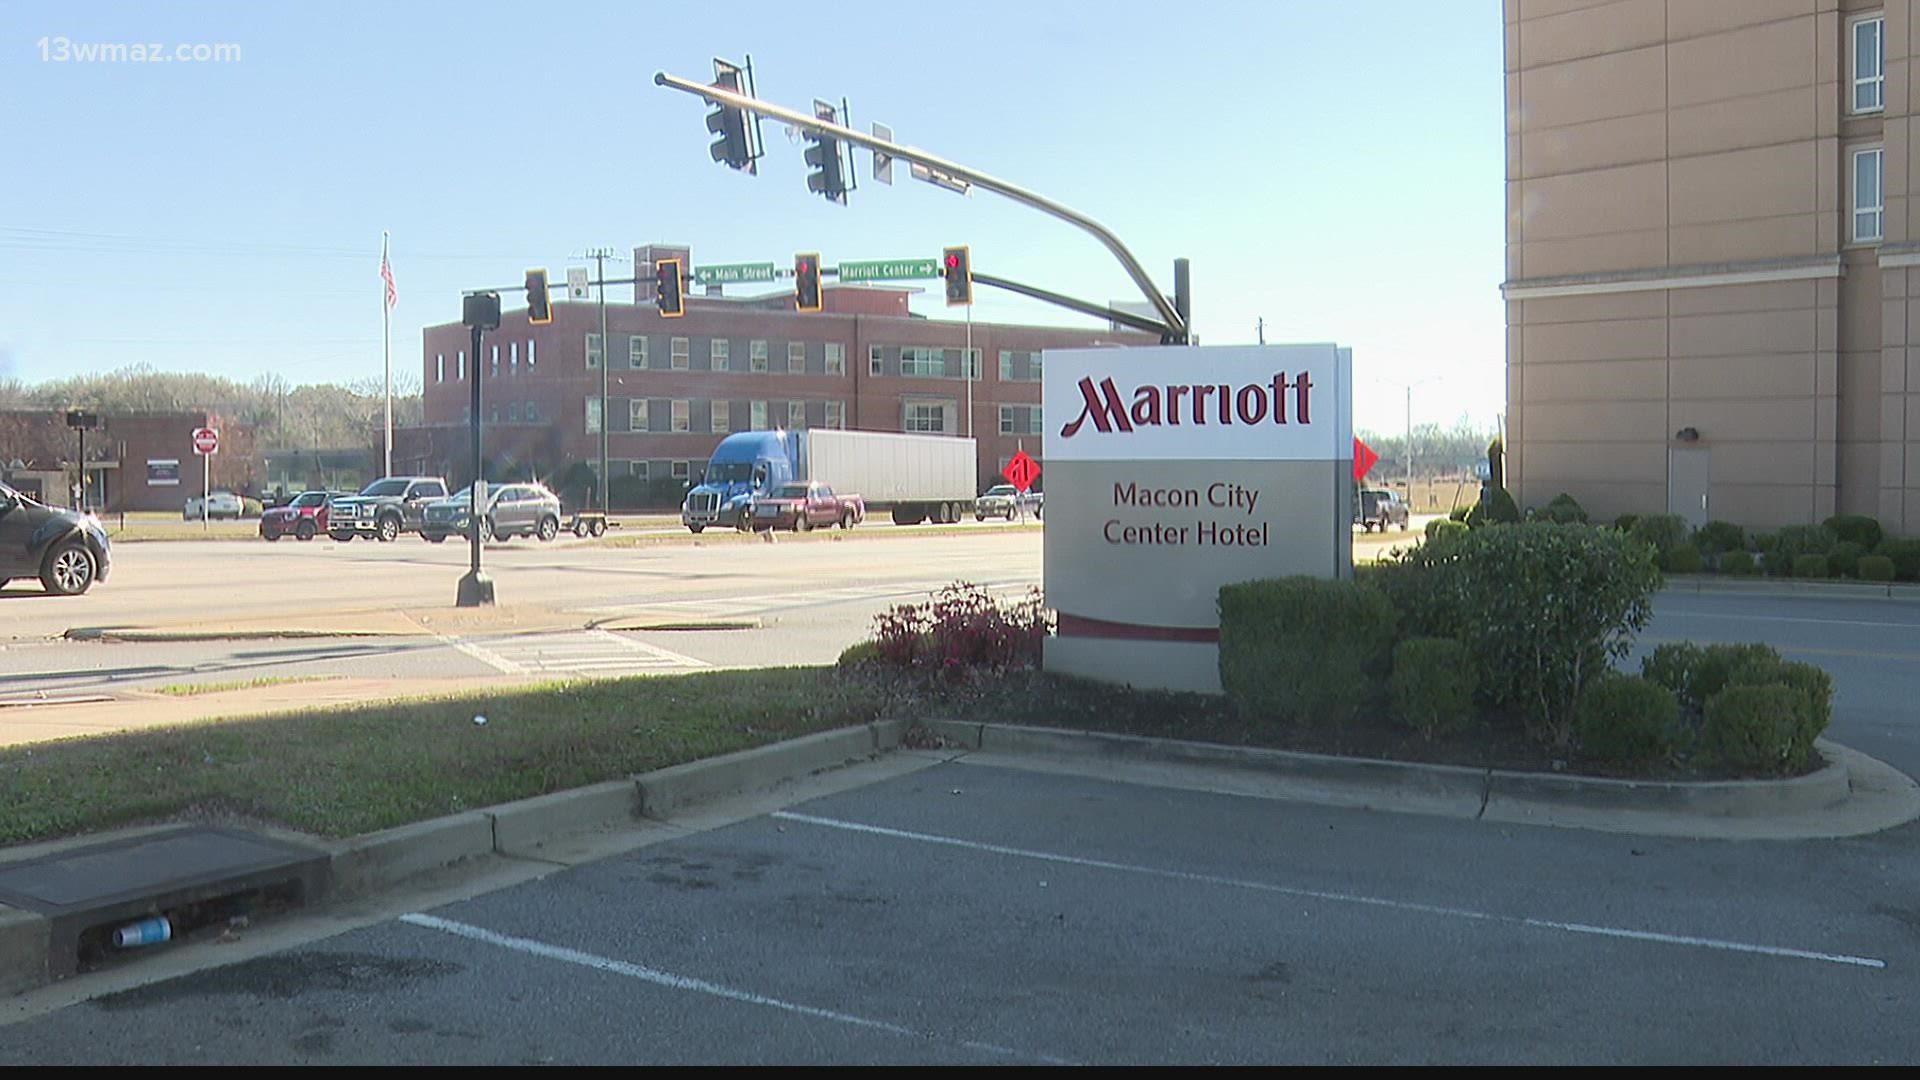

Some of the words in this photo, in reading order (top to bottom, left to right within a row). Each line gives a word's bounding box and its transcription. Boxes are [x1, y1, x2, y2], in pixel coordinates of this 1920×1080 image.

[715, 269, 739, 280] Main
[743, 267, 772, 279] Street
[841, 265, 879, 278] Marriott
[883, 264, 914, 276] Center
[1060, 370, 1313, 438] Marriott
[1114, 482, 1199, 507] Macon
[1207, 482, 1259, 515] City
[1103, 519, 1189, 545] Center
[1197, 520, 1268, 546] Hotel
